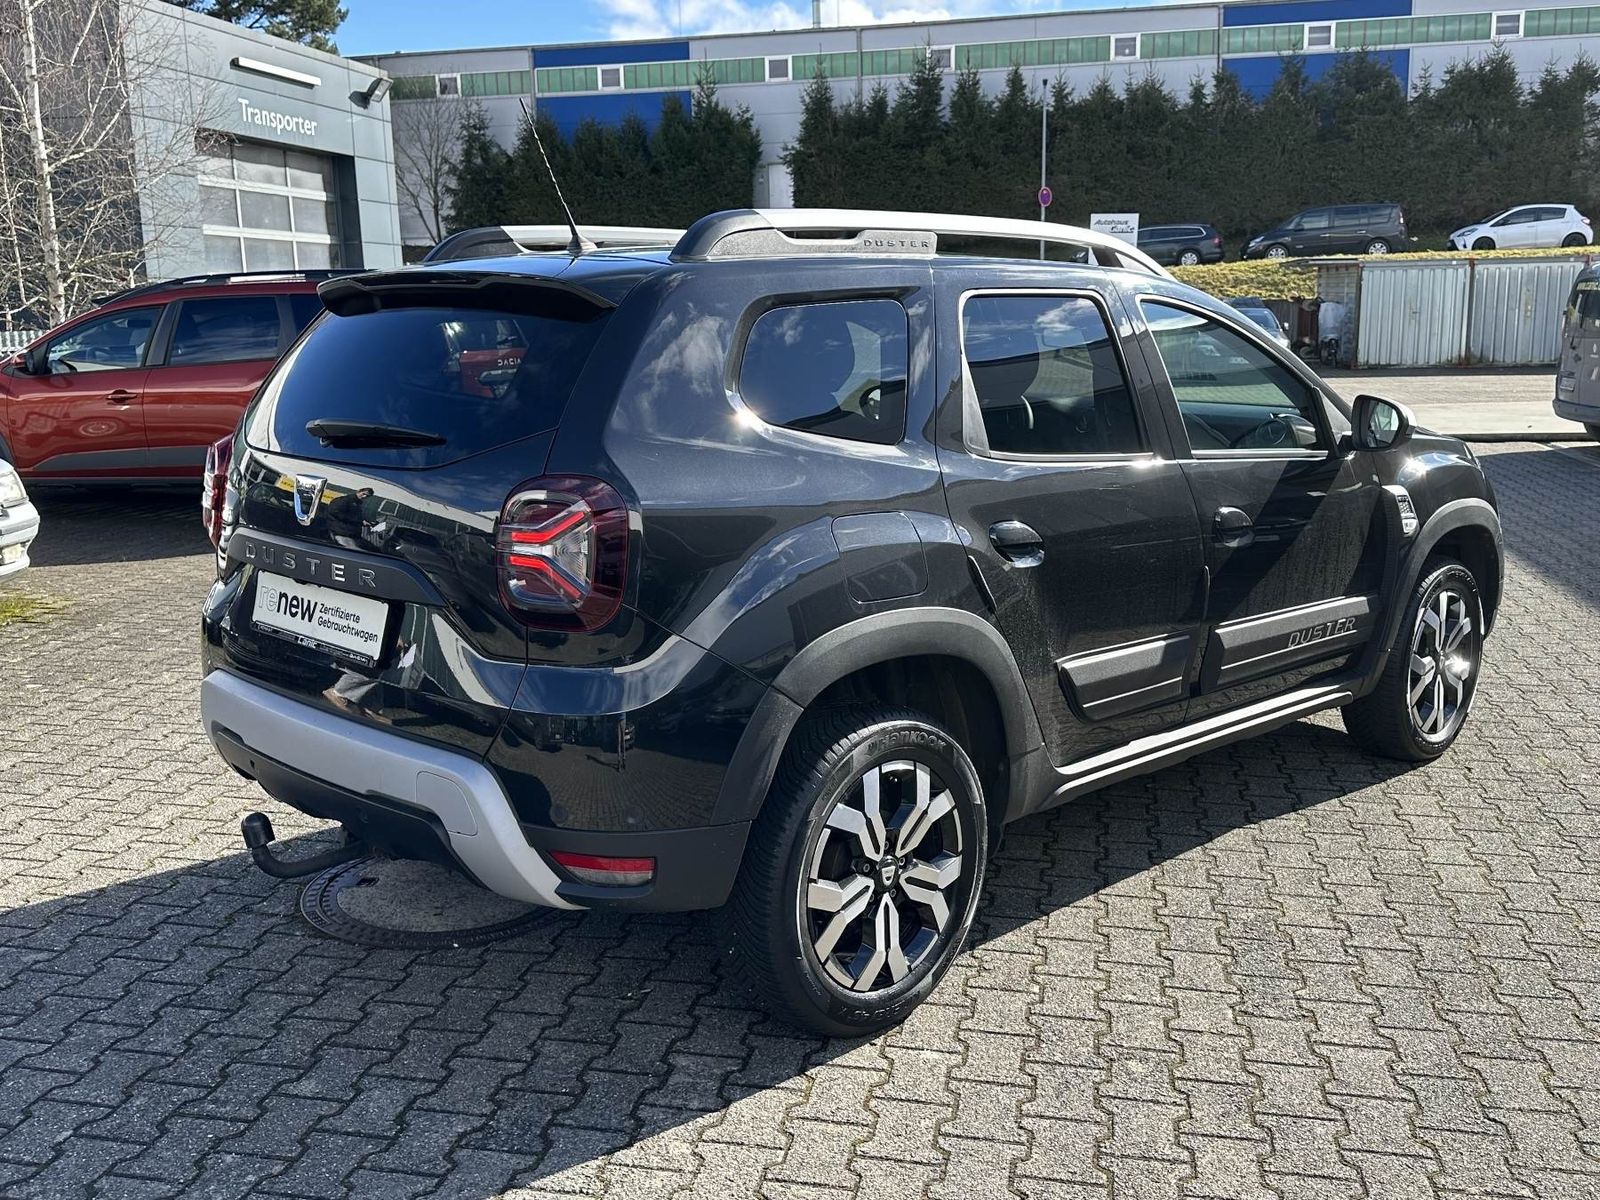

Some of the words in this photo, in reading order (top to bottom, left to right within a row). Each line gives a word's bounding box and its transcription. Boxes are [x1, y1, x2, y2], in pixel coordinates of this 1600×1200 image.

[238, 97, 317, 135] Transporter
[863, 239, 929, 248] DUSTER
[245, 541, 376, 588] DUSTER
[258, 585, 318, 623] renew
[319, 603, 361, 624] Zertifizierte
[317, 616, 379, 643] Gebrauchtwagen
[1288, 617, 1356, 648] DUSTER
